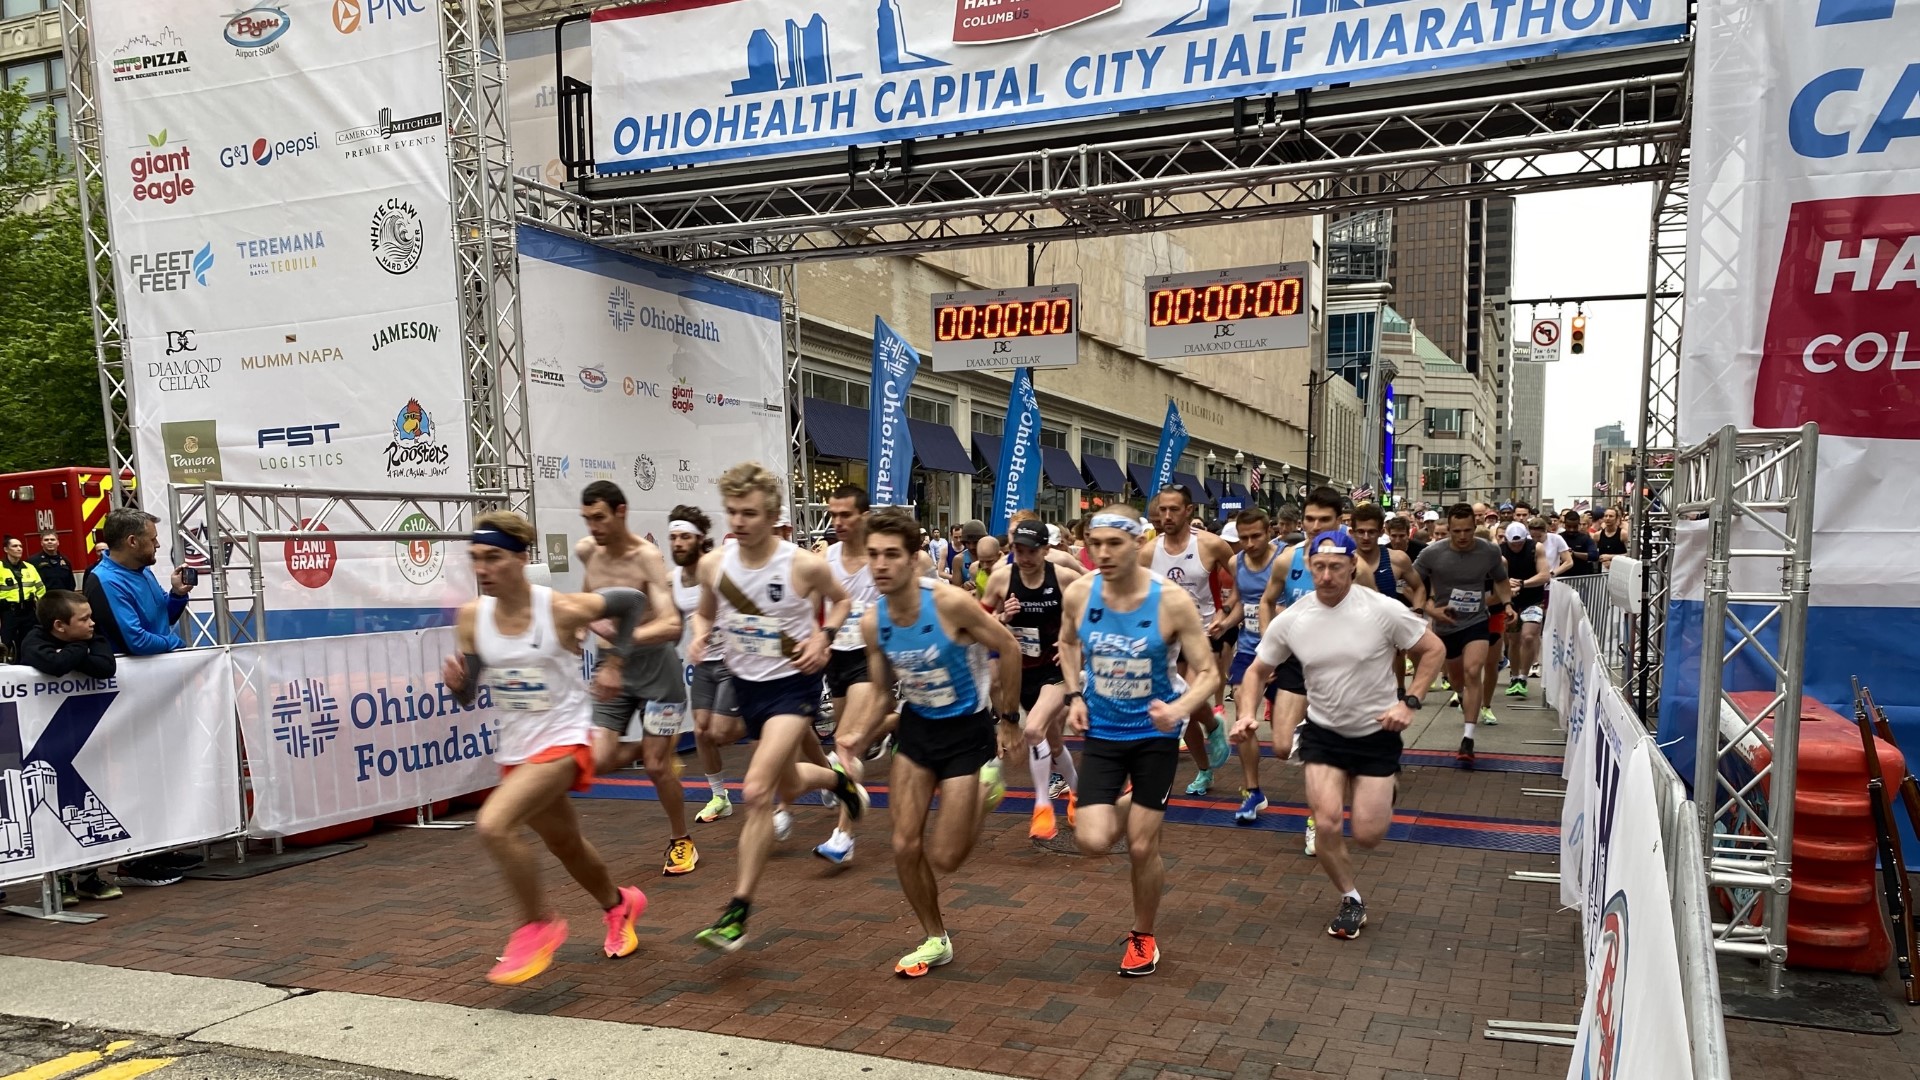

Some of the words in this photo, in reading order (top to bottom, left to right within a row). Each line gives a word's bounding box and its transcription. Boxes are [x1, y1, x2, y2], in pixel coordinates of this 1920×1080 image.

[231, 16, 279, 37] Byers
[962, 9, 1030, 29] COLUMBUS
[143, 50, 188, 69] PIZZA
[235, 48, 258, 60] Airport
[259, 42, 280, 57] Subaru
[612, 88, 856, 156] OHIOHEALTH
[873, 61, 1044, 123] CAPITAL
[1065, 45, 1166, 97] CITY
[1183, 37, 1304, 84] HALF
[1325, 0, 1652, 66] MARATHON
[338, 128, 380, 142] CAMERON
[392, 116, 441, 132] MITCHELL
[220, 144, 249, 168] G&J
[275, 132, 320, 160] pepsi
[345, 142, 391, 160] PREMIER
[395, 135, 437, 150] EVENTS
[131, 146, 190, 182] giant
[133, 173, 195, 204] eagle
[370, 204, 387, 252] WHITE
[387, 198, 418, 220] CLAW
[236, 231, 325, 259] TEREMANA
[381, 256, 402, 272] HARD
[404, 228, 421, 269] SELTZER
[130, 249, 194, 275] FLEET
[271, 255, 317, 273] TEQUILA
[139, 270, 191, 294] FEET
[249, 269, 269, 277] BATCH
[1153, 278, 1300, 326] 00:00:00
[640, 307, 720, 343] OhioHealth
[939, 299, 1070, 340] 00:00:00
[166, 329, 197, 356] DC
[372, 321, 438, 352] JAMESON
[1184, 341, 1231, 353] DIAMOND
[1233, 338, 1268, 349] CELLAR
[241, 352, 294, 370] MUMM
[298, 347, 344, 367] NAPA
[966, 357, 1008, 368] DIAMOND
[1010, 355, 1041, 365] CELLAR
[1803, 332, 1920, 373] COL
[148, 357, 221, 377] DIAMOND
[544, 371, 564, 382] PIZZA
[158, 374, 210, 392] CELLAR
[637, 380, 660, 398] PNC
[672, 385, 693, 400] giant
[672, 399, 694, 413] eagle
[725, 397, 741, 406] pepsi
[257, 423, 340, 448] FST
[876, 381, 901, 505] OhioHealt
[170, 453, 215, 467] Panera
[259, 452, 344, 470] LOGISTICS
[383, 441, 449, 472] Roosters
[537, 455, 561, 467] FLEET
[579, 458, 616, 470] TEREMANA
[1004, 412, 1033, 520] OhioHealth
[539, 467, 560, 479] FEET
[672, 474, 699, 483] DIAMOND
[677, 483, 695, 491] CELLAR
[294, 540, 327, 554] LAND
[414, 540, 426, 562] 5
[291, 553, 331, 571] GRANT
[400, 552, 417, 577] SALAD
[418, 551, 439, 578] KITCHEN
[1088, 631, 1135, 651] FLEET
[34, 676, 119, 696] PROMISE
[354, 718, 501, 782] Foundati
